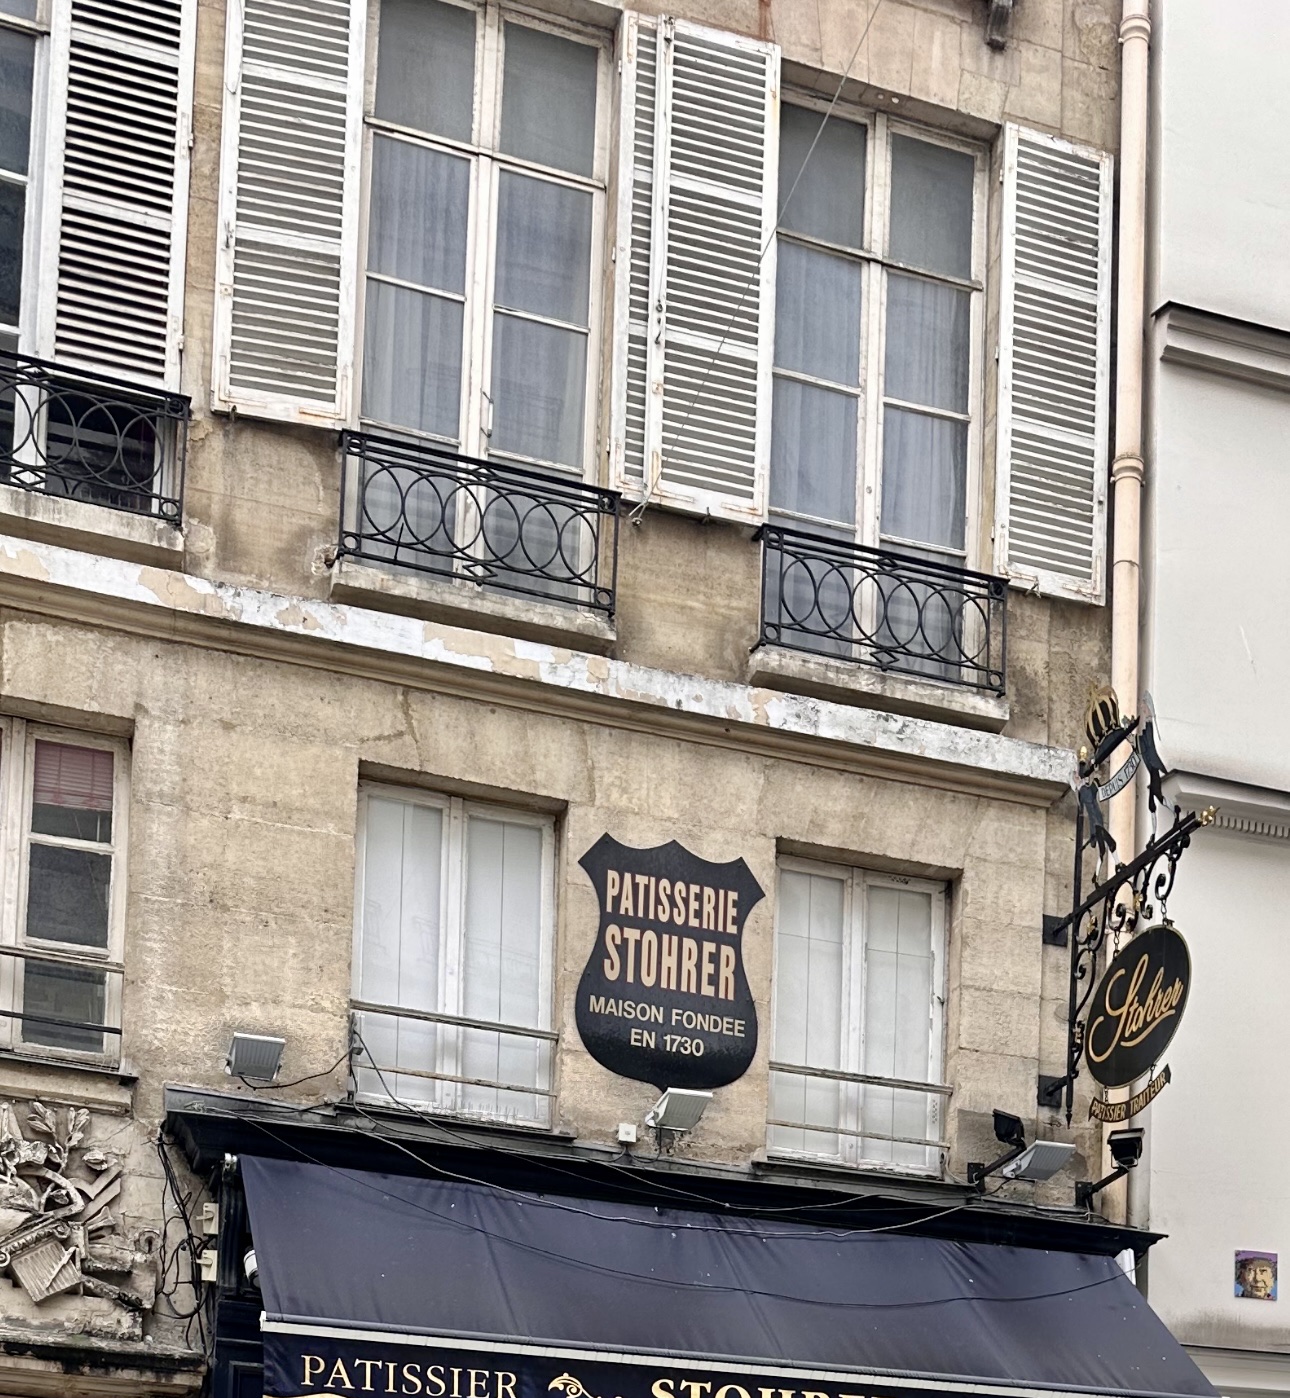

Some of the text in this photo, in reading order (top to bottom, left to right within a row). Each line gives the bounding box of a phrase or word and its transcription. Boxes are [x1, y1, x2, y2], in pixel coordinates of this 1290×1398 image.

[606, 869, 739, 935] PATISSERIE
[603, 923, 736, 1001] STOHRER
[589, 995, 746, 1038] MAISON FONDEE
[1088, 953, 1184, 1063] Stohrer
[630, 1028, 705, 1057] EN 1730
[1091, 1072, 1166, 1121] PATISSIER TRAITEUR
